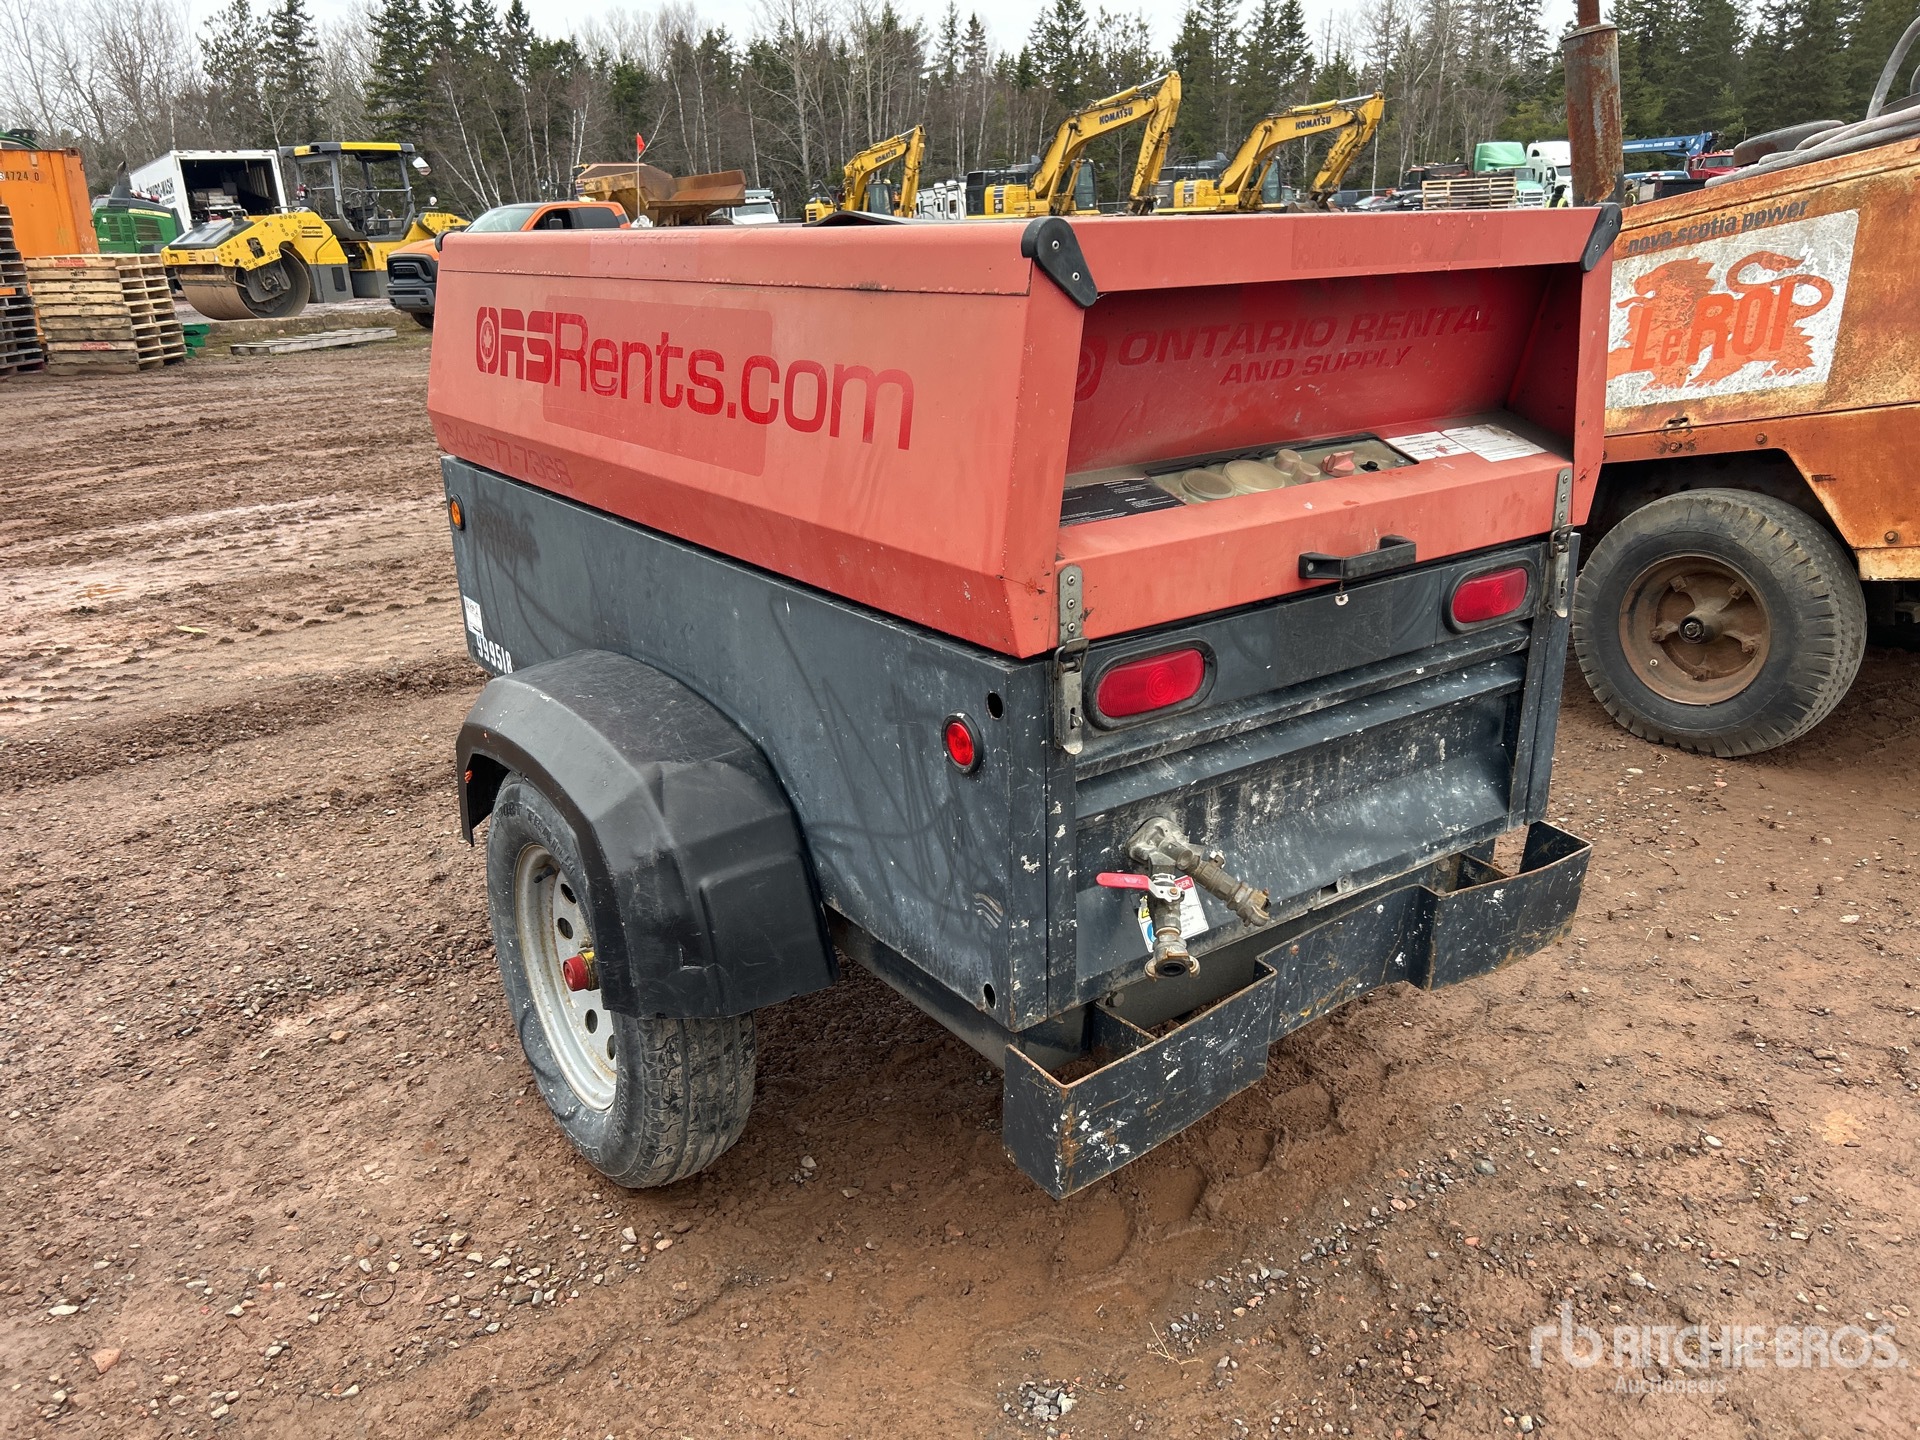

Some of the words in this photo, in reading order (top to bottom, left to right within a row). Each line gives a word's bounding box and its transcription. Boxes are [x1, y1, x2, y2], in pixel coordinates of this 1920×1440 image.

[1099, 106, 1134, 125] KOMATSU
[1295, 115, 1332, 130] KOMATSU
[875, 149, 897, 164] KOMATSU
[1627, 230, 1672, 254] nova
[1676, 214, 1737, 243] scotia
[1741, 199, 1810, 233] power
[1118, 315, 1342, 365] ONTARIO
[1346, 304, 1498, 344] RENTAL
[1629, 277, 1795, 371] LeROI
[475, 305, 914, 451] ORSRents.com
[1219, 356, 1295, 386] AND
[1301, 345, 1412, 377] SUPPLY
